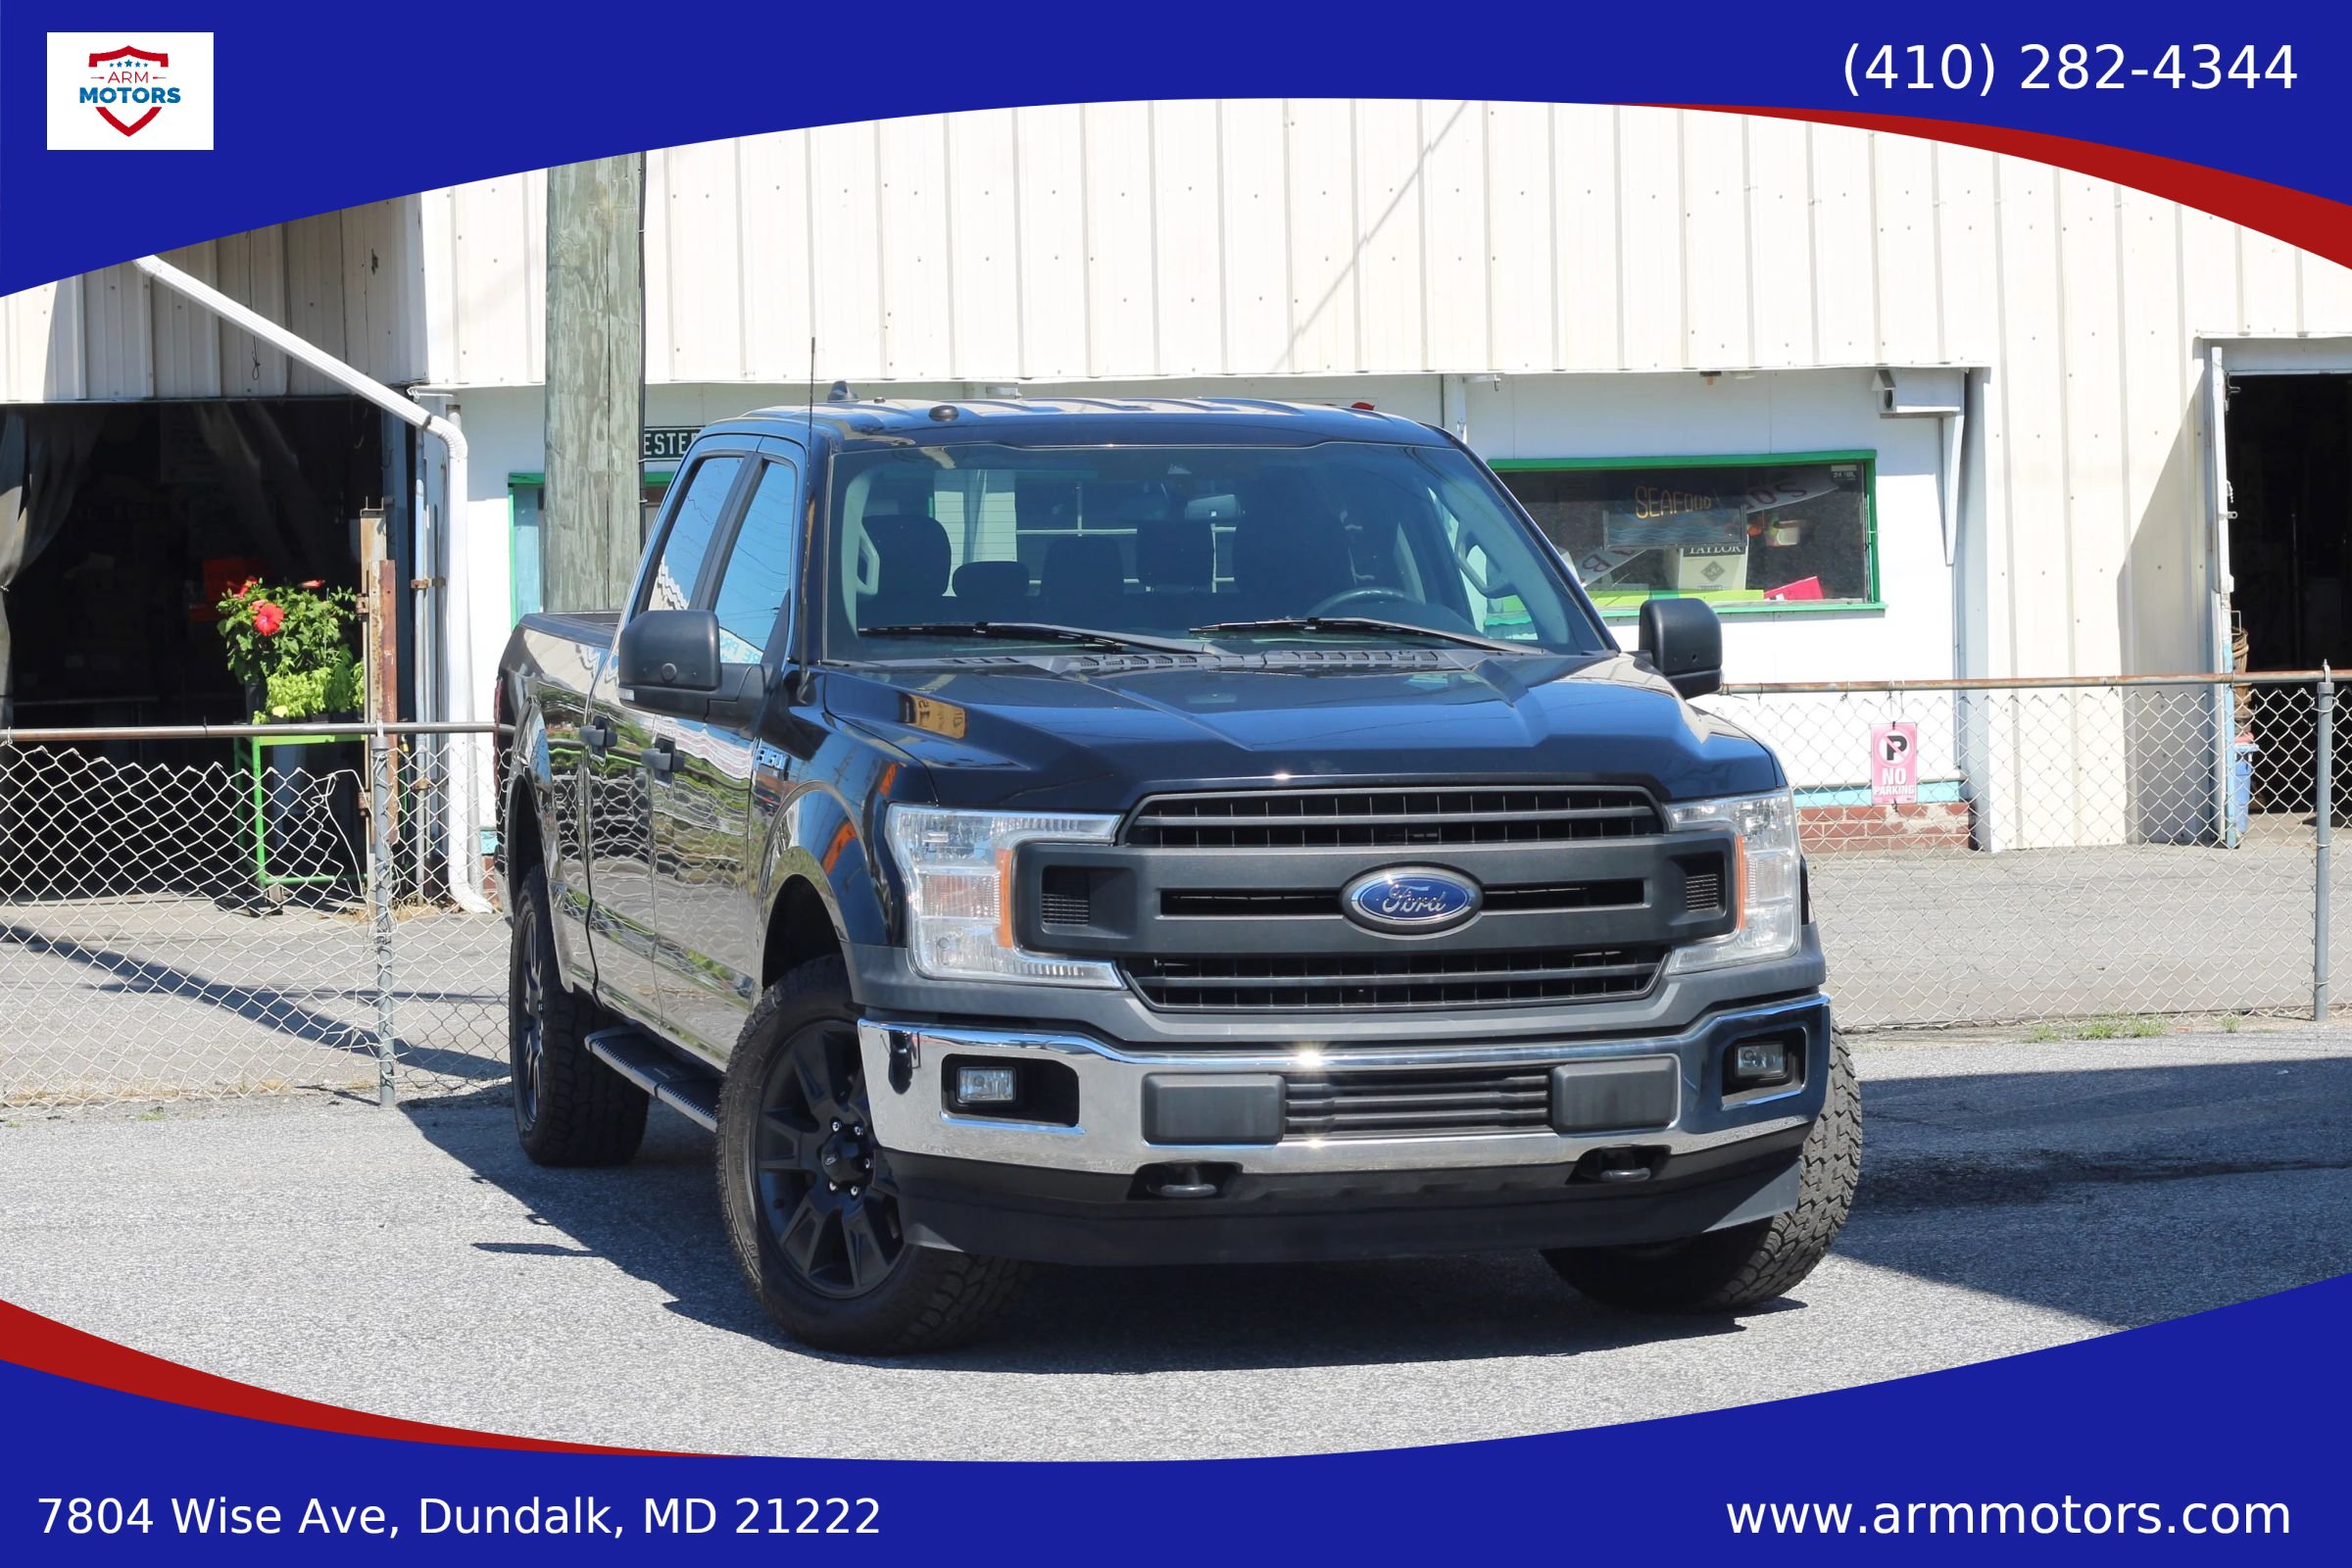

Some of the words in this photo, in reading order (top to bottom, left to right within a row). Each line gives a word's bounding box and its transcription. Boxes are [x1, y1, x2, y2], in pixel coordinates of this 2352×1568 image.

[1634, 485, 1712, 519] SEAFOOD
[1882, 768, 1907, 785] NO
[1874, 786, 1915, 796] PARKING
[1383, 885, 1446, 912] Ford
